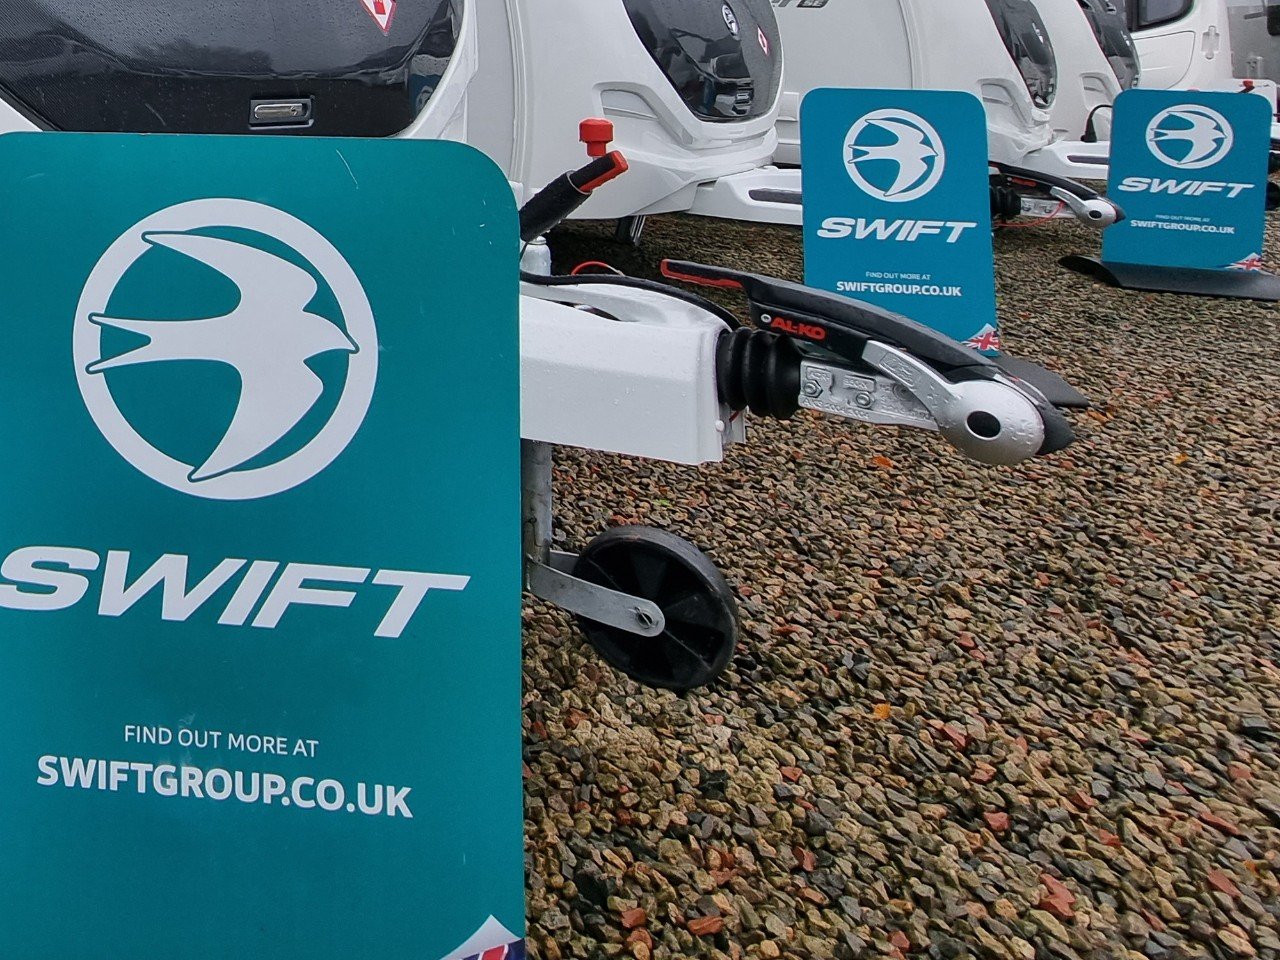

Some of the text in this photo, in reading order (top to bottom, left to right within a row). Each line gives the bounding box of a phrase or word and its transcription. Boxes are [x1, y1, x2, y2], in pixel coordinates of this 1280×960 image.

[1117, 177, 1255, 198] SWIFT
[816, 217, 977, 243] SWIFT
[1130, 220, 1235, 234] SWIFTGROUP.CO.UK
[865, 271, 883, 279] FIND
[836, 281, 962, 297] SWIFTGROUP.CO.UK
[124, 725, 319, 757] FIND OUT MORE AT
[36, 755, 414, 818] SWIFTGROUP.CO.UK
